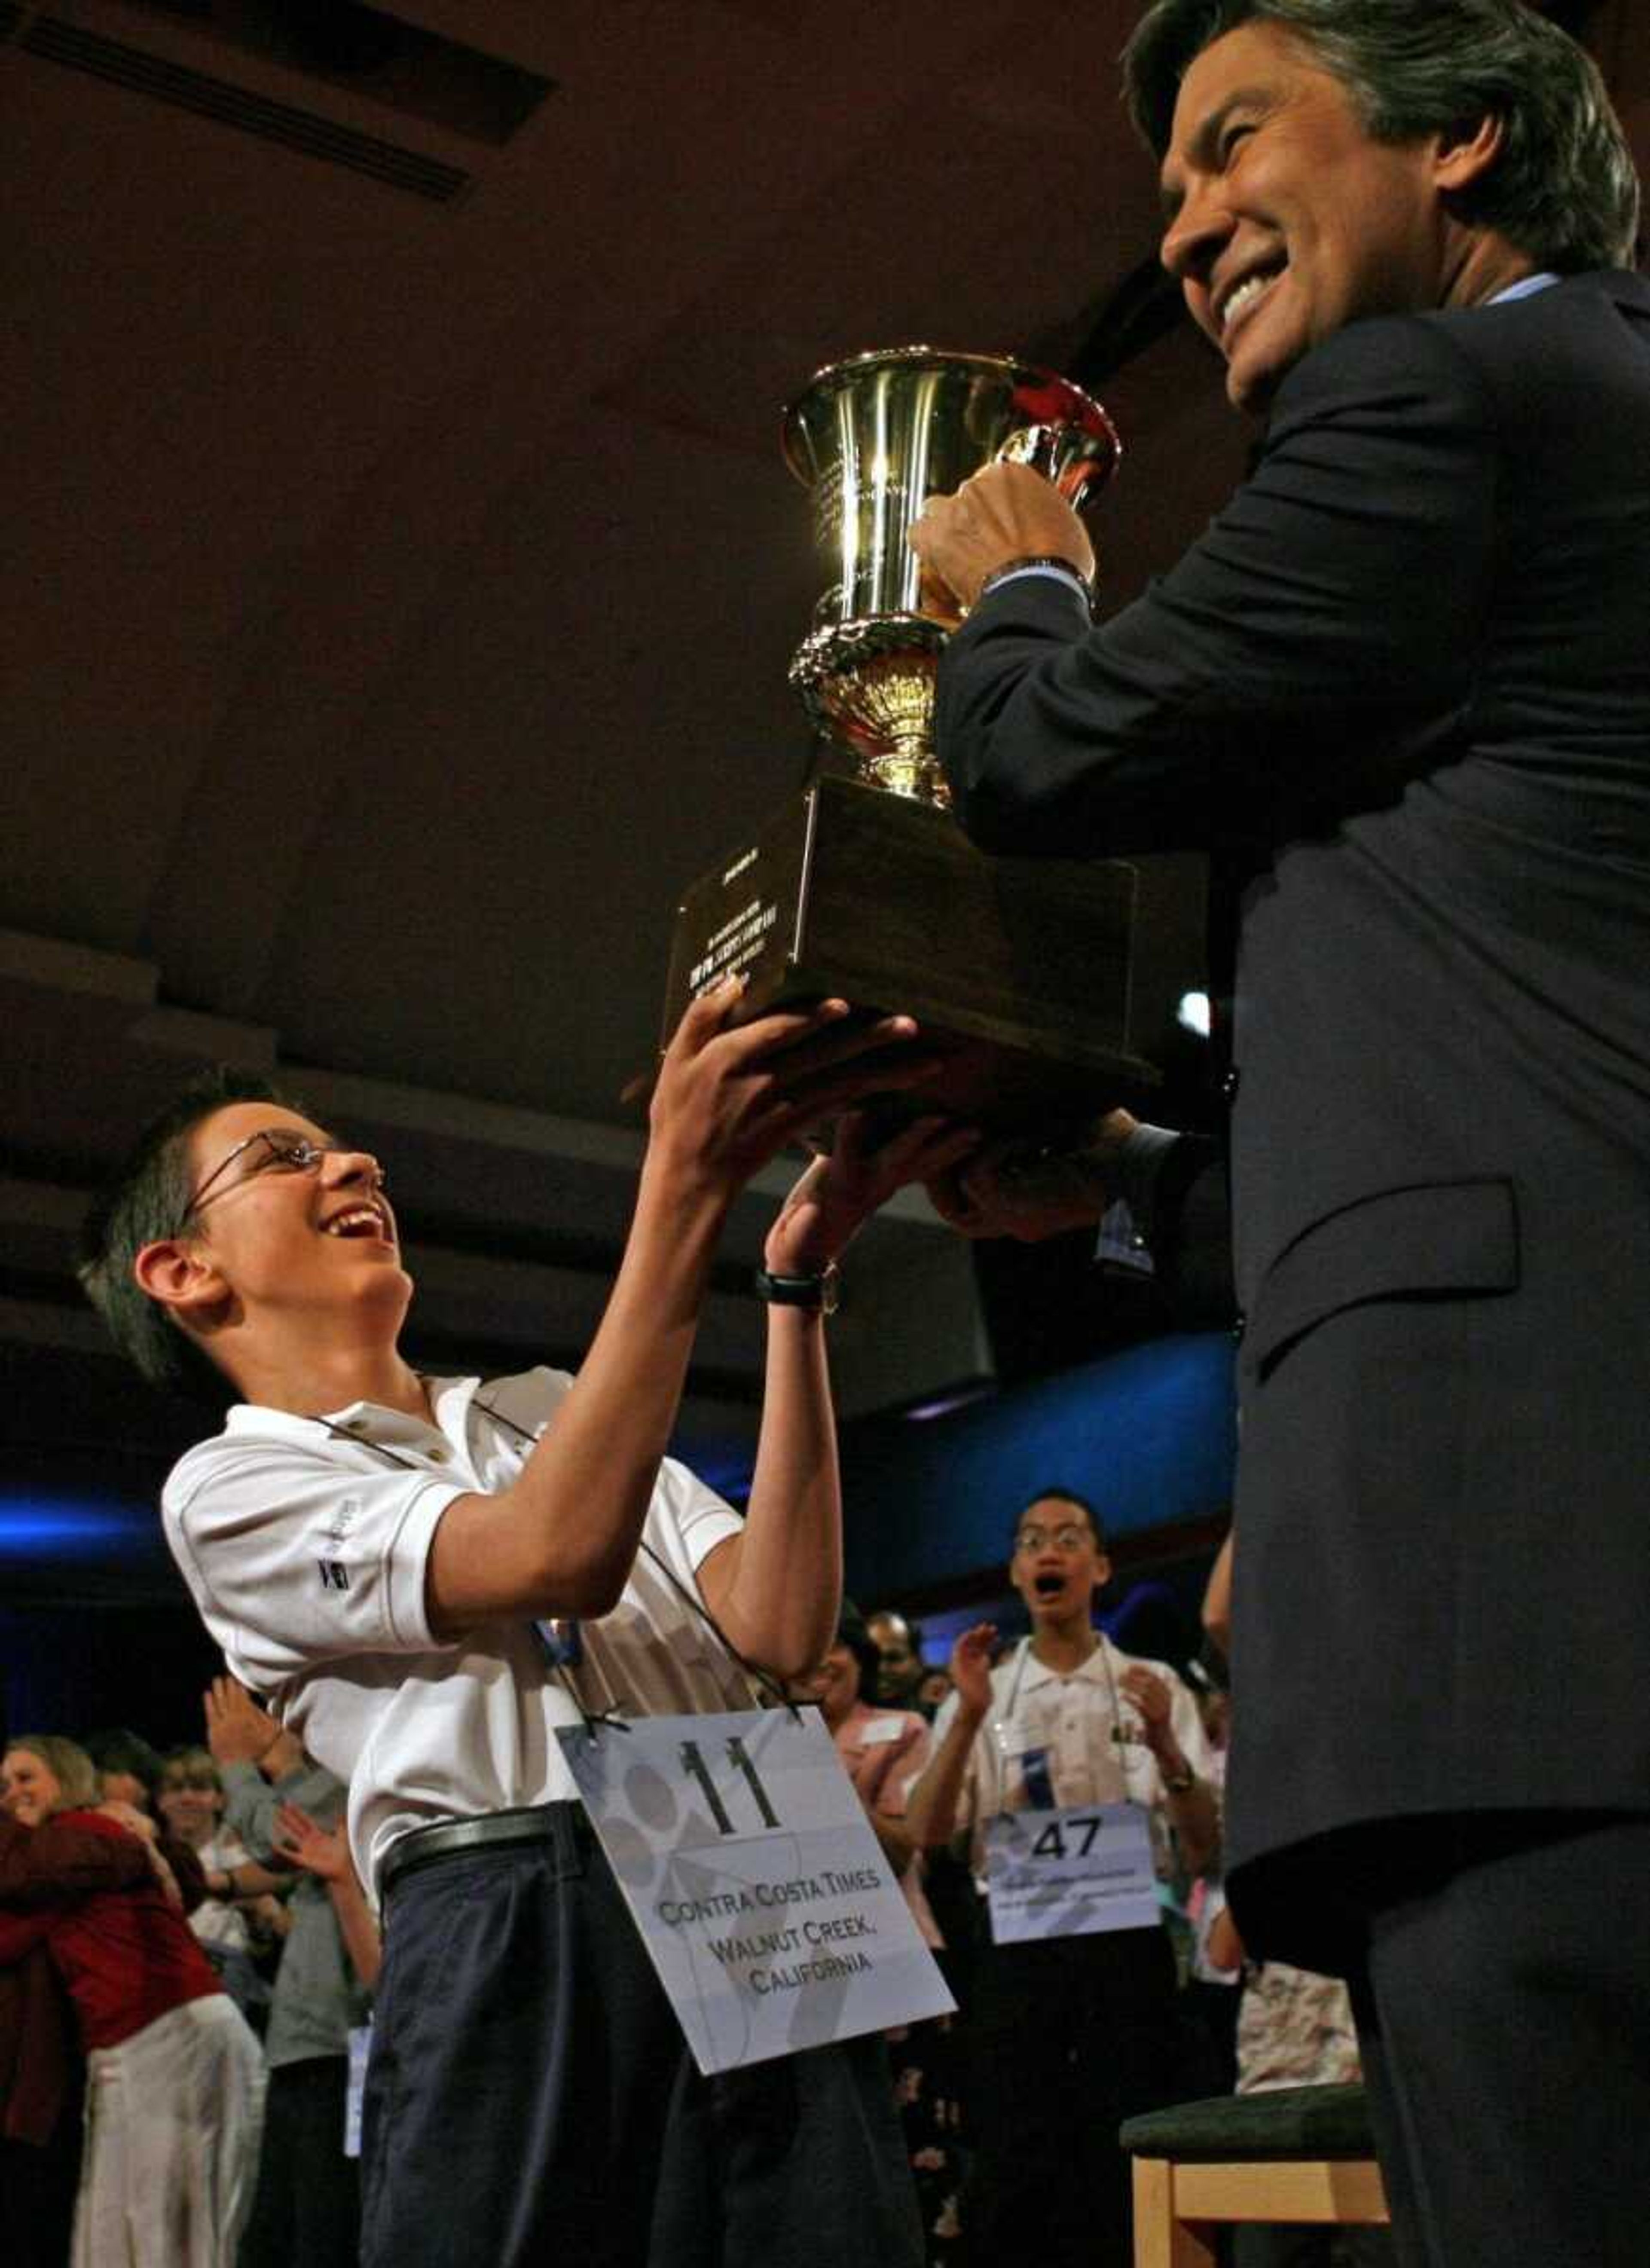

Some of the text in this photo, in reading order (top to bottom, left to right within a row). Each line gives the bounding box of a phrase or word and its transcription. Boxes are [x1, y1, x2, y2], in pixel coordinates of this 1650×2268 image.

[678, 1736, 782, 1835] 11
[1032, 1816, 1102, 1859] 47
[659, 1870, 880, 1926] CONTRA COSTA TIMES
[707, 1929, 801, 1965] WALNUT
[749, 1952, 874, 1994] CALIFORNIA
